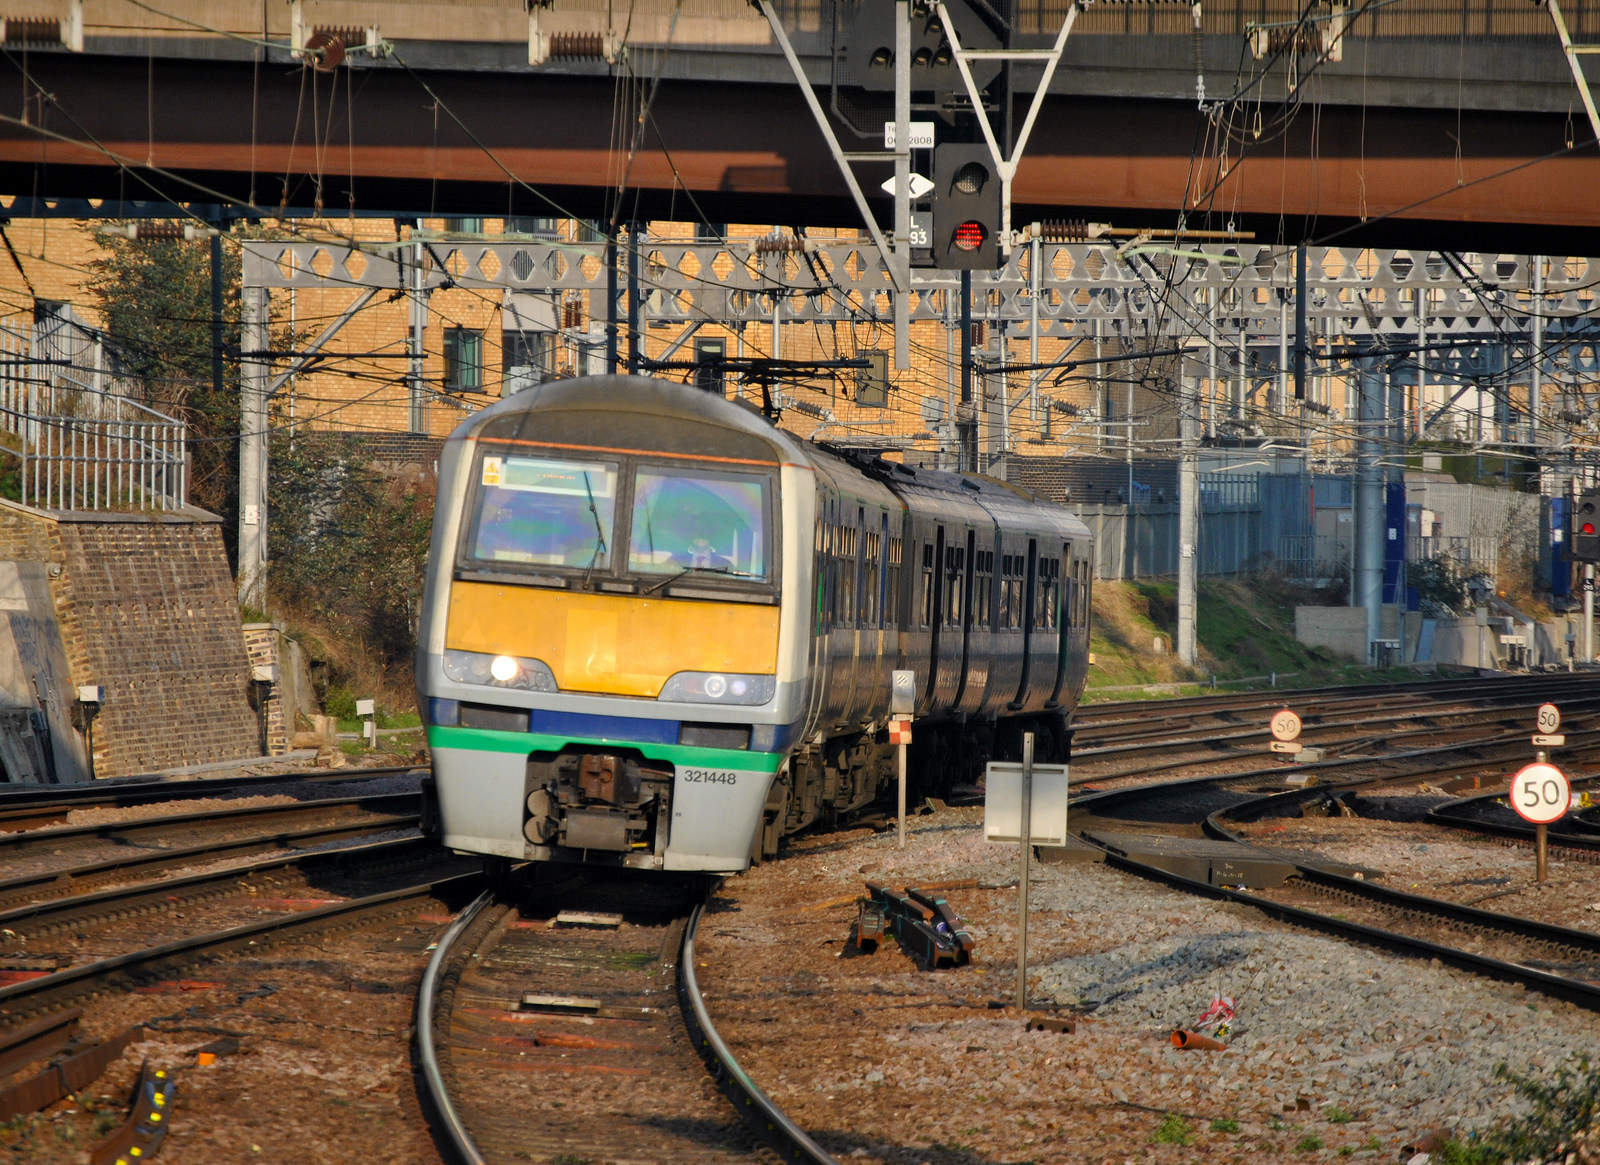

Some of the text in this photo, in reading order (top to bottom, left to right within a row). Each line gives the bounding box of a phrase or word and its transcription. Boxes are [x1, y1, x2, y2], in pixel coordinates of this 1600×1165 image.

[1276, 719, 1296, 733] 50
[1539, 711, 1556, 727] 50
[684, 769, 736, 785] 321448
[1523, 779, 1560, 808] 50
